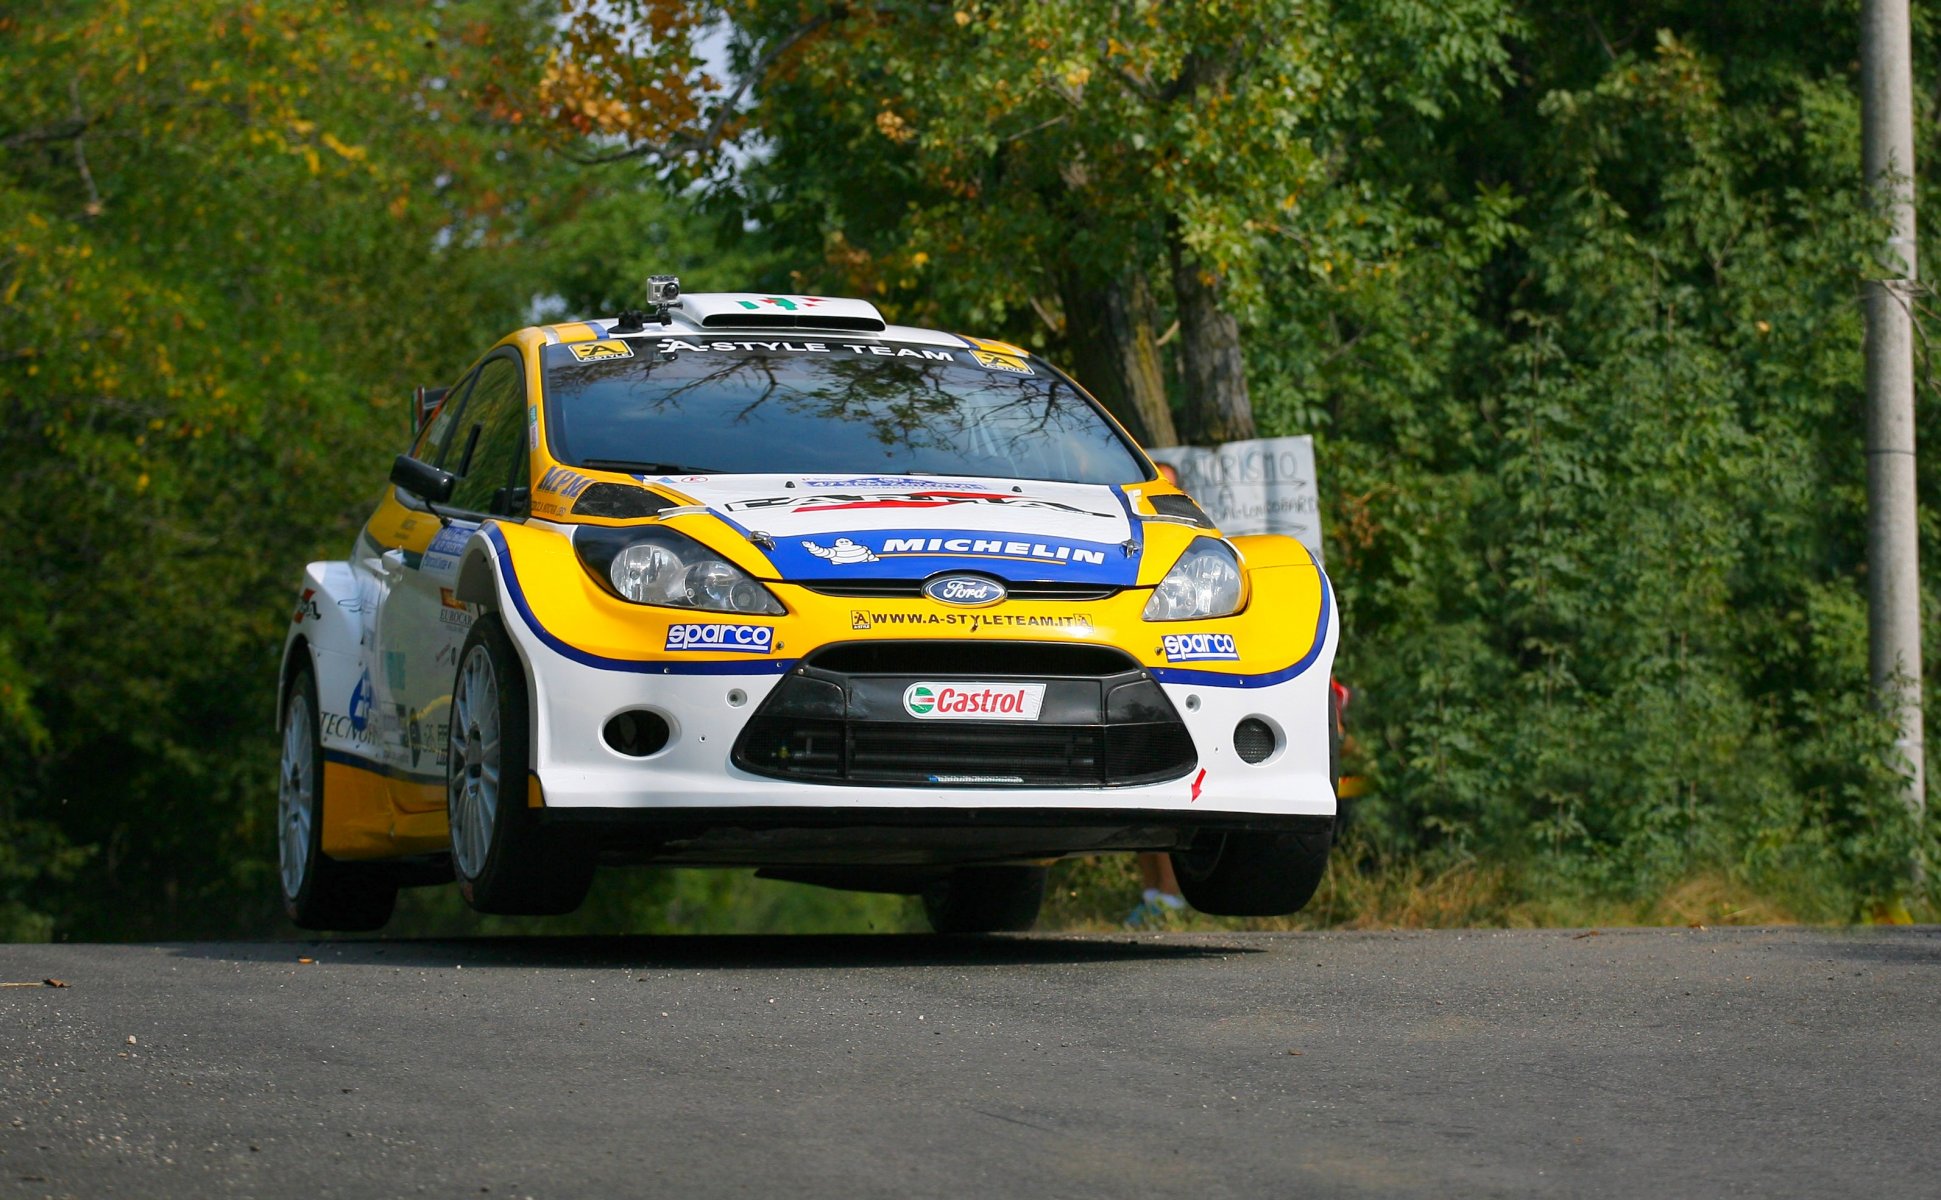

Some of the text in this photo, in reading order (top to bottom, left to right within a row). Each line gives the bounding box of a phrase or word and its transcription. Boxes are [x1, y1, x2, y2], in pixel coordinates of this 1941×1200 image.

[657, 339, 954, 361] A-STYLE TEAM
[538, 466, 595, 498] MPM
[883, 538, 1105, 565] MICHELIN
[943, 581, 988, 599] Ford
[440, 609, 472, 626] EUROCAR
[871, 613, 1074, 628] WWW.A-STYLETEAM.IT
[668, 624, 771, 649] sparco
[1164, 634, 1235, 660] sparco
[937, 688, 1025, 713] Castrol
